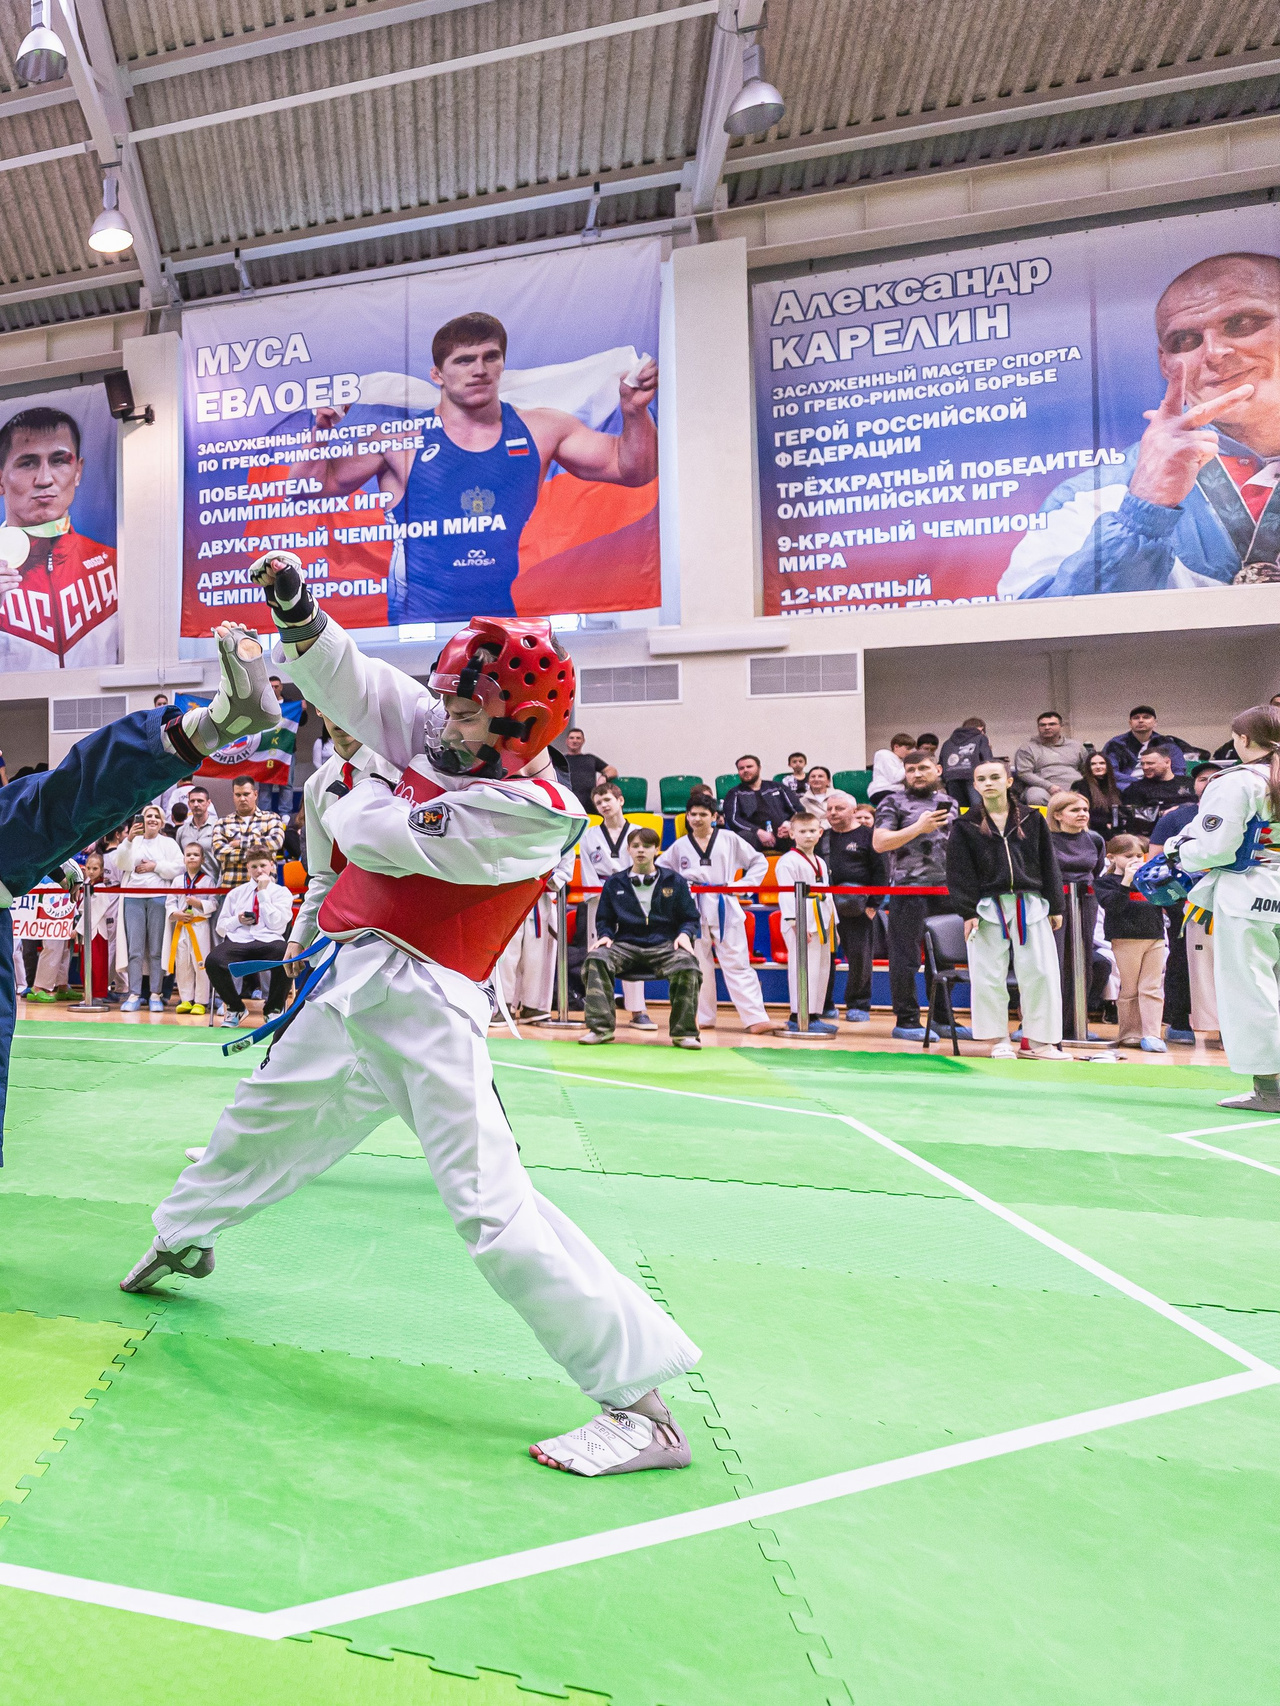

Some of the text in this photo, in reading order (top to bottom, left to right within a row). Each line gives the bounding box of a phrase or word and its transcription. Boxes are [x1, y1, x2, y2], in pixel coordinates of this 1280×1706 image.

[771, 257, 1051, 326] Александр
[196, 332, 312, 378] МУСА
[771, 303, 1010, 371] КАРЕЛИН
[772, 346, 1081, 400] ЗАСЛУЖЕННЫЙ МАСТЕР СПОРТА
[773, 368, 1058, 418] ПО ГРЕКО-РИМСКОЙ БОРЬБЕ
[196, 372, 361, 423] ЕВЛОЕВ
[198, 416, 443, 455] ЗАСЛУЖЕННЫЙ МАСТЕР СПОРТА
[775, 398, 1027, 447] ГЕРОЙ РОССИЙСКОЙ
[198, 436, 425, 473] ПО ГРЕКО-РИМСКОЙ БОРЬБЕ
[775, 436, 921, 468] ФЕДЕРАЦИИ
[199, 477, 323, 504] ПОБЕДИТЕЛЬ
[777, 448, 1125, 498] ТРЁХКРАТНЫЙ ПОБЕДИТЕЛЬ
[199, 492, 394, 525] ОЛИМПИЙСКИХ ИГР
[777, 480, 1019, 519] ОЛИМПИЙСКИХ ИГР
[197, 514, 506, 559] ДВУКРАТНЫЙ ЧЕМПИОН МИРА
[777, 512, 1047, 552] 9-КРАТНЫЙ ЧЕМПИОН
[779, 552, 847, 573] МИРА
[0, 565, 118, 643] ОССИЯ
[199, 588, 267, 606] ЧЕМПИ
[781, 574, 932, 606] 12-КРАТНЫЙ
[212, 750, 251, 764] РИДАН
